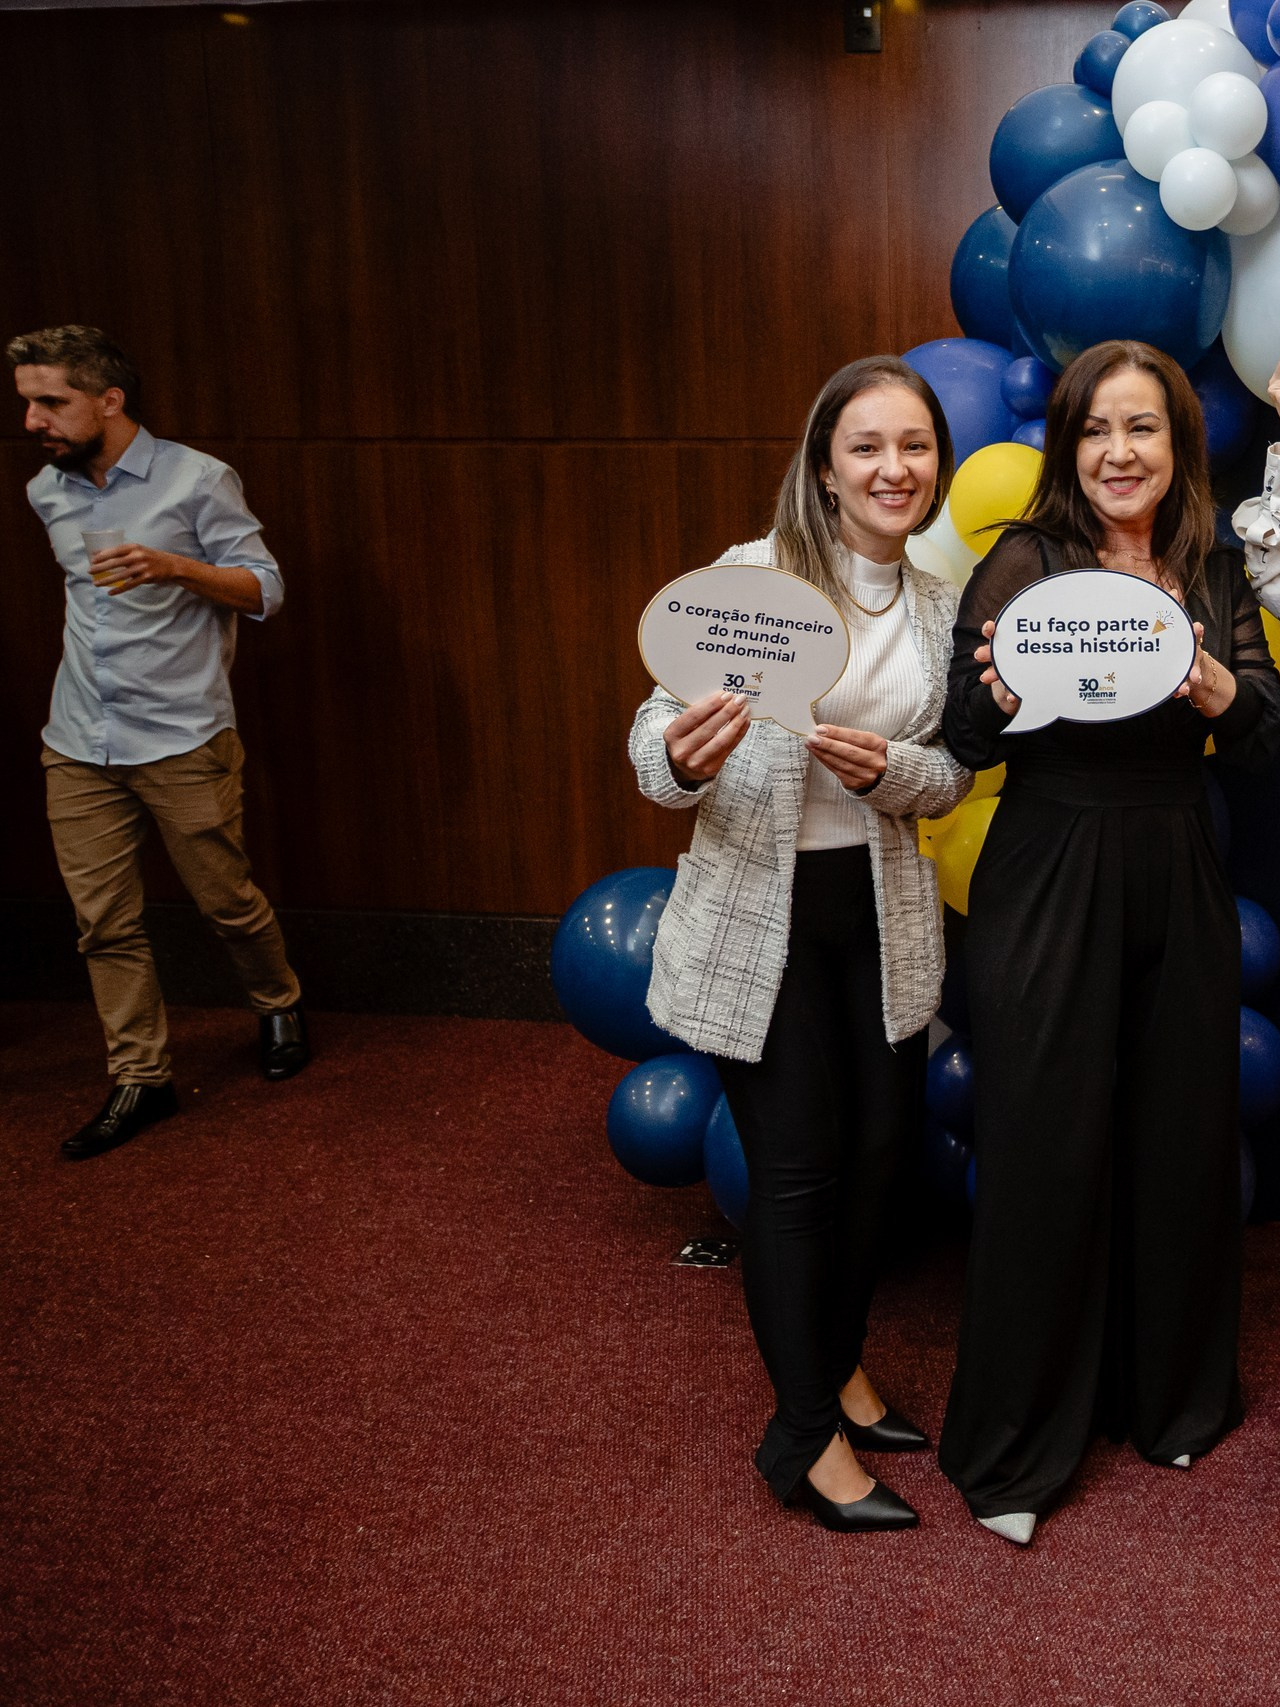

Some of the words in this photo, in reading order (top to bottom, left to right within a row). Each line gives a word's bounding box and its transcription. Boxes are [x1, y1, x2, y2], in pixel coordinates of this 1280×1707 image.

[668, 601, 681, 613] O
[685, 605, 750, 623] coração
[754, 613, 833, 635] financeiro
[1016, 618, 1041, 633] Eu
[1047, 617, 1091, 636] faço
[1097, 617, 1149, 635] parte
[708, 624, 728, 637] do
[733, 629, 790, 646] mundo
[696, 640, 796, 663] condominial
[1016, 638, 1073, 654] dessa
[1080, 637, 1160, 653] história!
[723, 673, 745, 688] 30
[1078, 678, 1099, 691] 30
[1079, 691, 1117, 701] systemar
